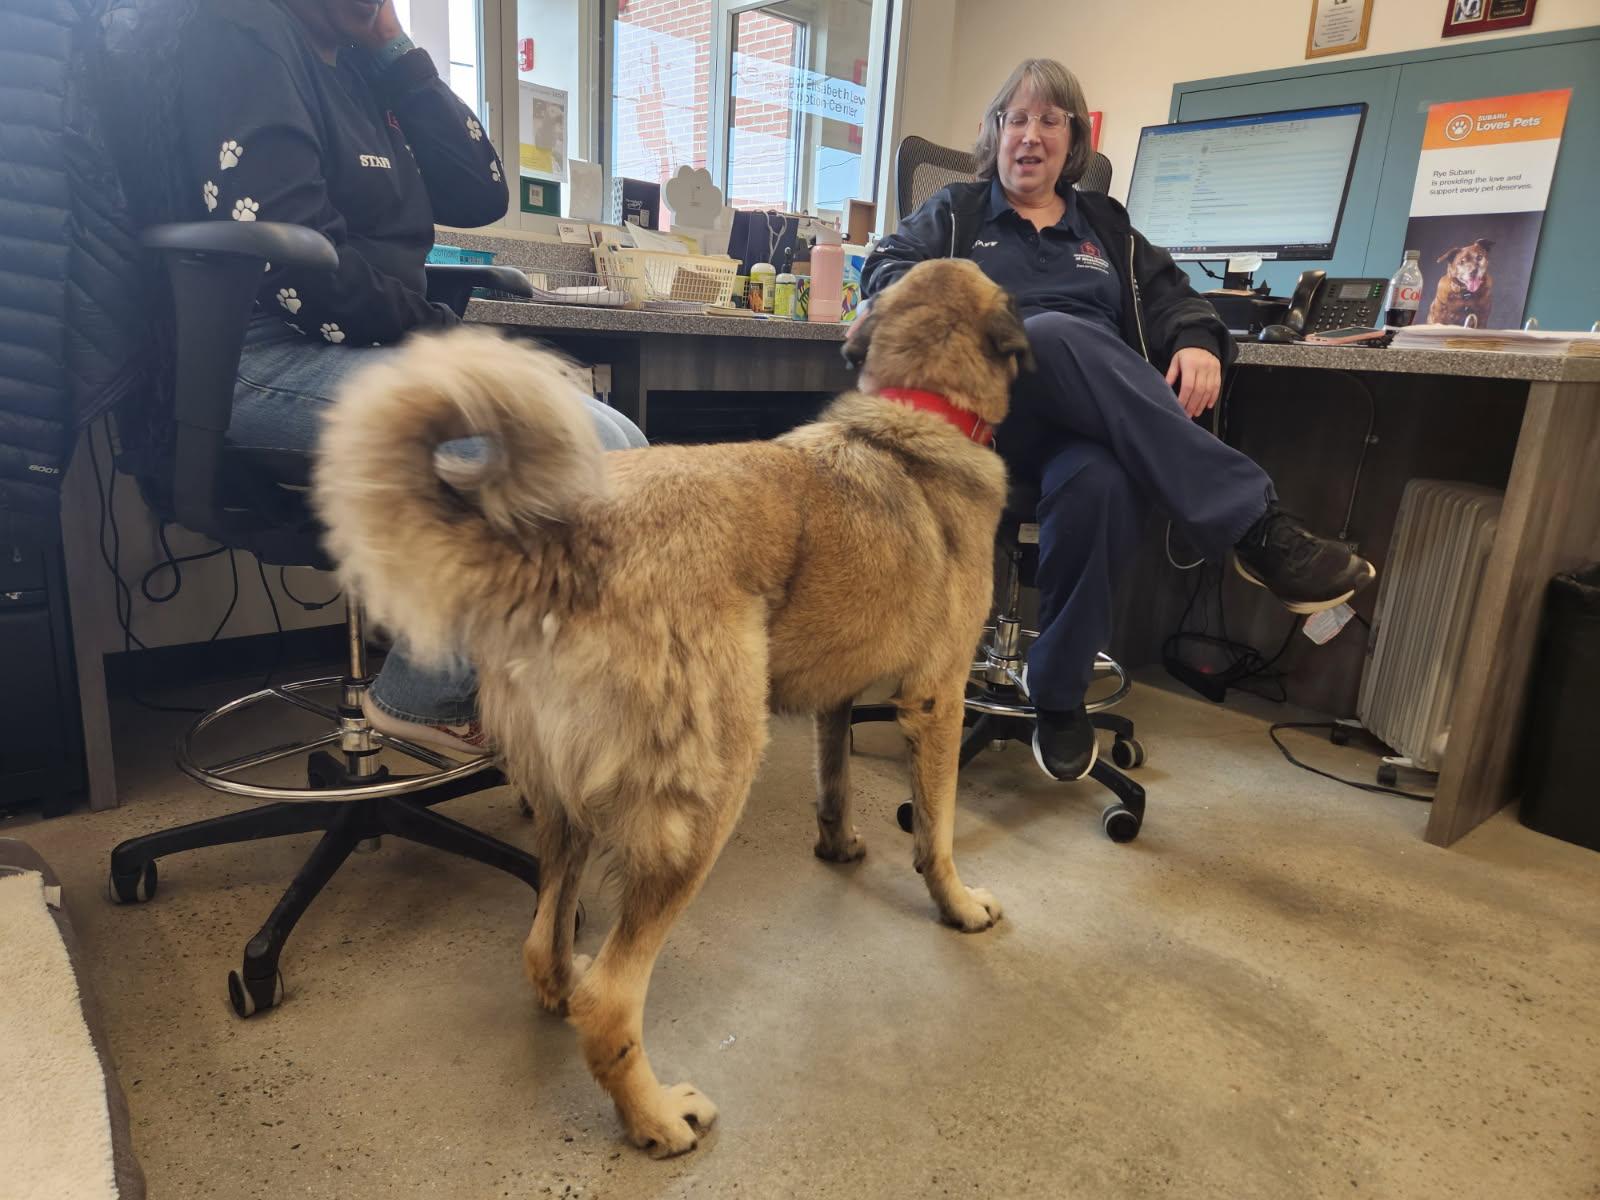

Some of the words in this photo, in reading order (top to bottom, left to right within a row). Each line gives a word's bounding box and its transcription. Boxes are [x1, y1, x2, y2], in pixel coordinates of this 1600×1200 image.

[1476, 121, 1510, 130] Loves
[1513, 117, 1541, 127] Pets
[1433, 170, 1447, 178] Rye
[1449, 168, 1476, 177] Subaru
[1439, 178, 1473, 187] providing
[1430, 187, 1458, 195] support
[1460, 186, 1480, 194] every
[1496, 183, 1533, 191] deserves.
